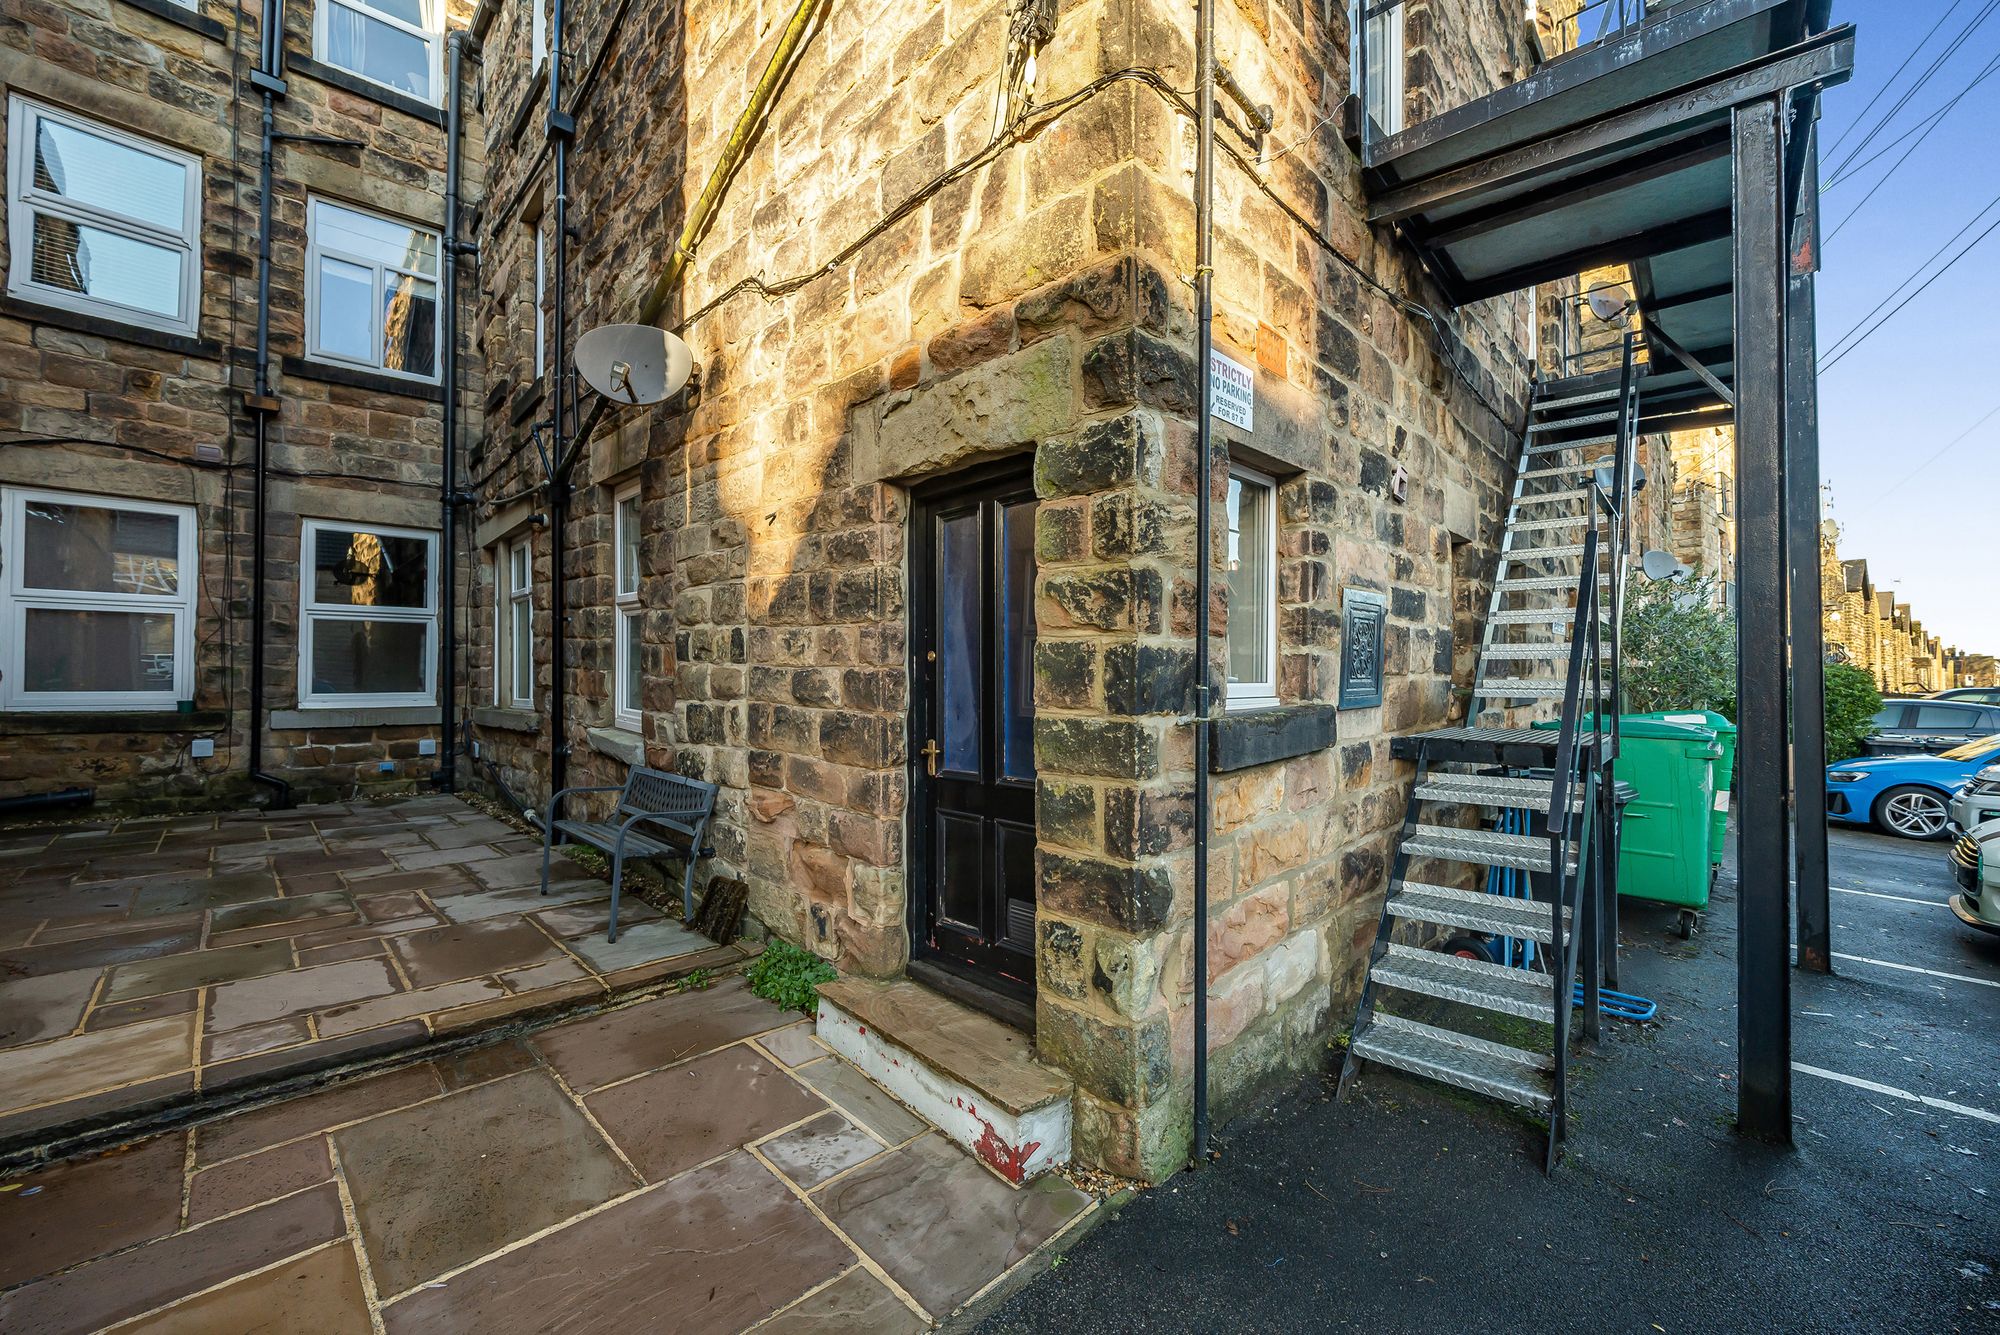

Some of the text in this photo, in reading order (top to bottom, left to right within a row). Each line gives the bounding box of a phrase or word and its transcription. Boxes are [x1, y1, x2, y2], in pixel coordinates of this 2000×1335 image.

[1211, 357, 1251, 390] STRICTLY
[1222, 379, 1252, 406] PARKING
[1216, 395, 1246, 416] RESERVED
[1218, 407, 1230, 419] FOR
